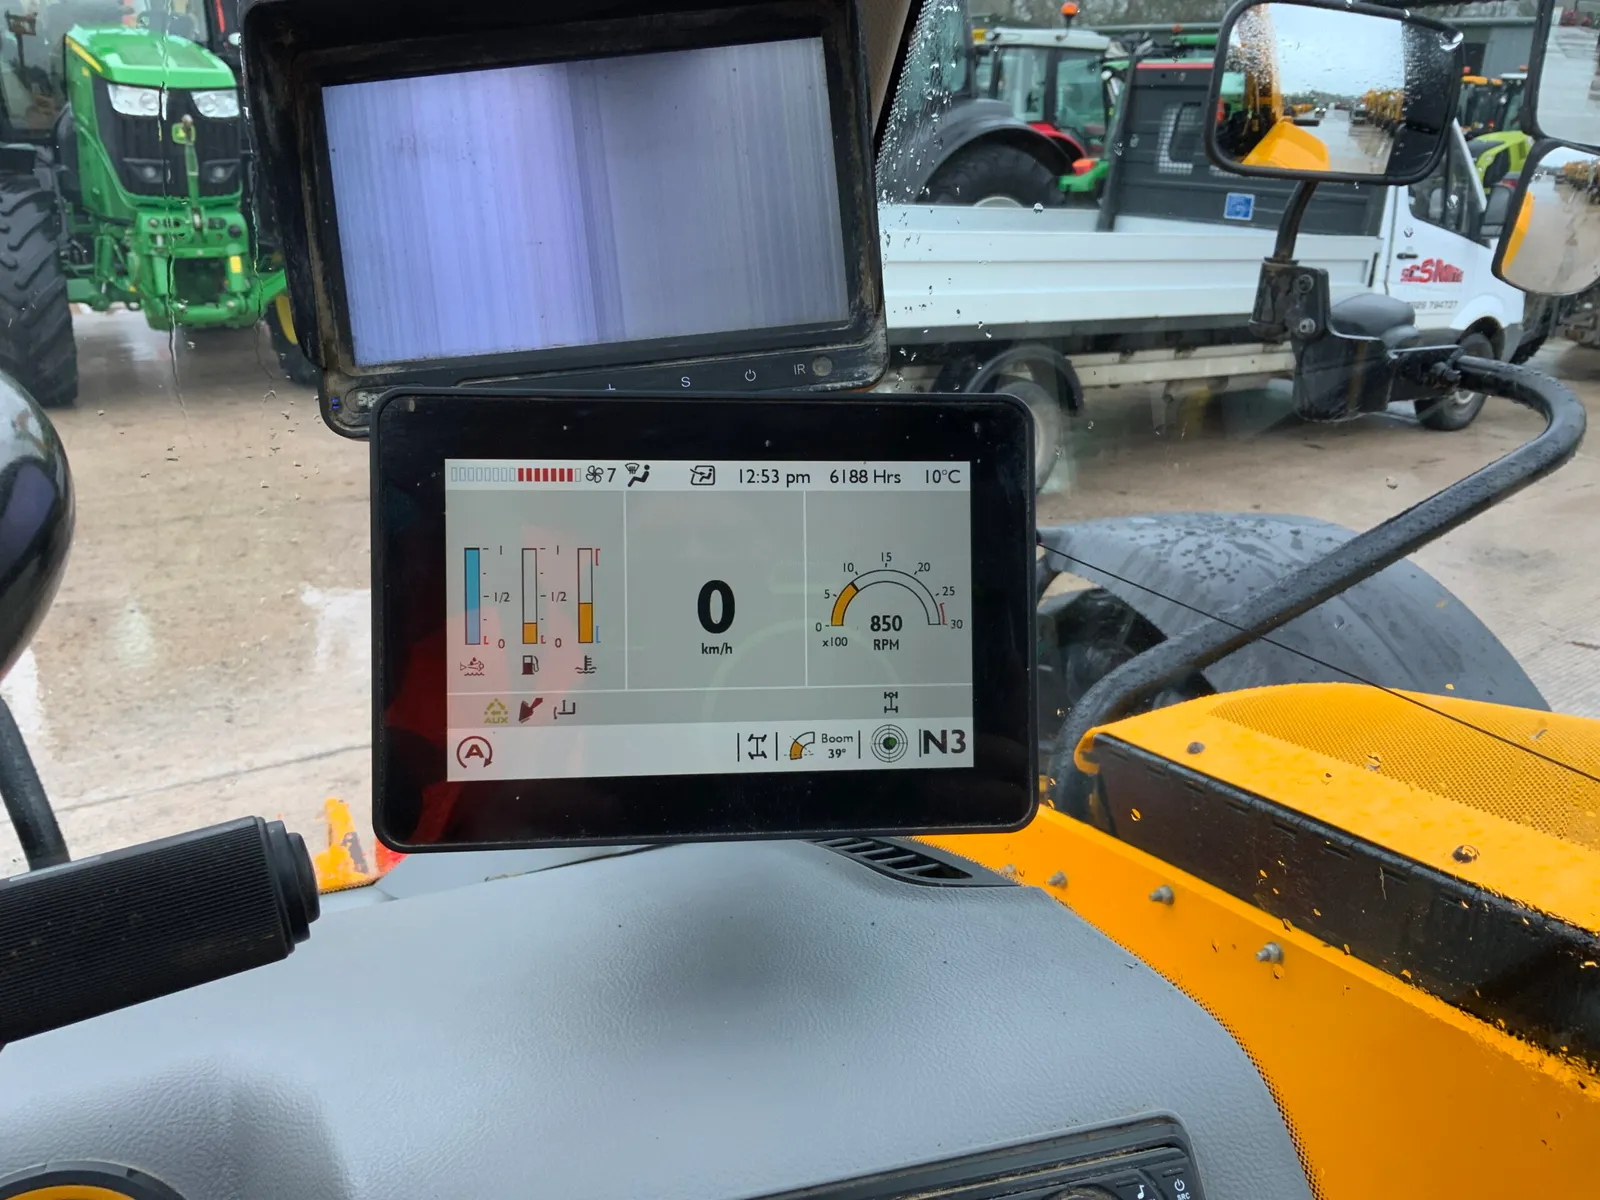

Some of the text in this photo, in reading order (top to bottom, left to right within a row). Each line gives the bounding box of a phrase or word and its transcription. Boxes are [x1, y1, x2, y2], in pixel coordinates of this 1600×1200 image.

[793, 364, 806, 375] IR
[680, 376, 691, 388] S
[606, 467, 617, 483] 7
[739, 469, 811, 487] 12:53 pm
[829, 469, 902, 484] 6188 Hrs
[925, 469, 961, 484] 10°C
[881, 552, 892, 562] 15
[843, 562, 854, 572] 10
[918, 562, 931, 572] 20
[551, 591, 567, 602] 1/2
[824, 589, 830, 599] 5
[942, 586, 955, 596] 25
[494, 592, 510, 603] 1/2
[697, 579, 736, 634] 0
[815, 622, 822, 632] 0
[870, 615, 903, 632] 850
[950, 619, 963, 629] 30
[497, 639, 506, 649] 0
[554, 638, 562, 648] 0
[822, 637, 848, 647] x100
[873, 639, 900, 650] RPM
[701, 642, 733, 655] km/h
[821, 733, 853, 744] Boom
[922, 729, 967, 754] N3
[465, 744, 484, 758] A
[828, 748, 847, 759] 39°
